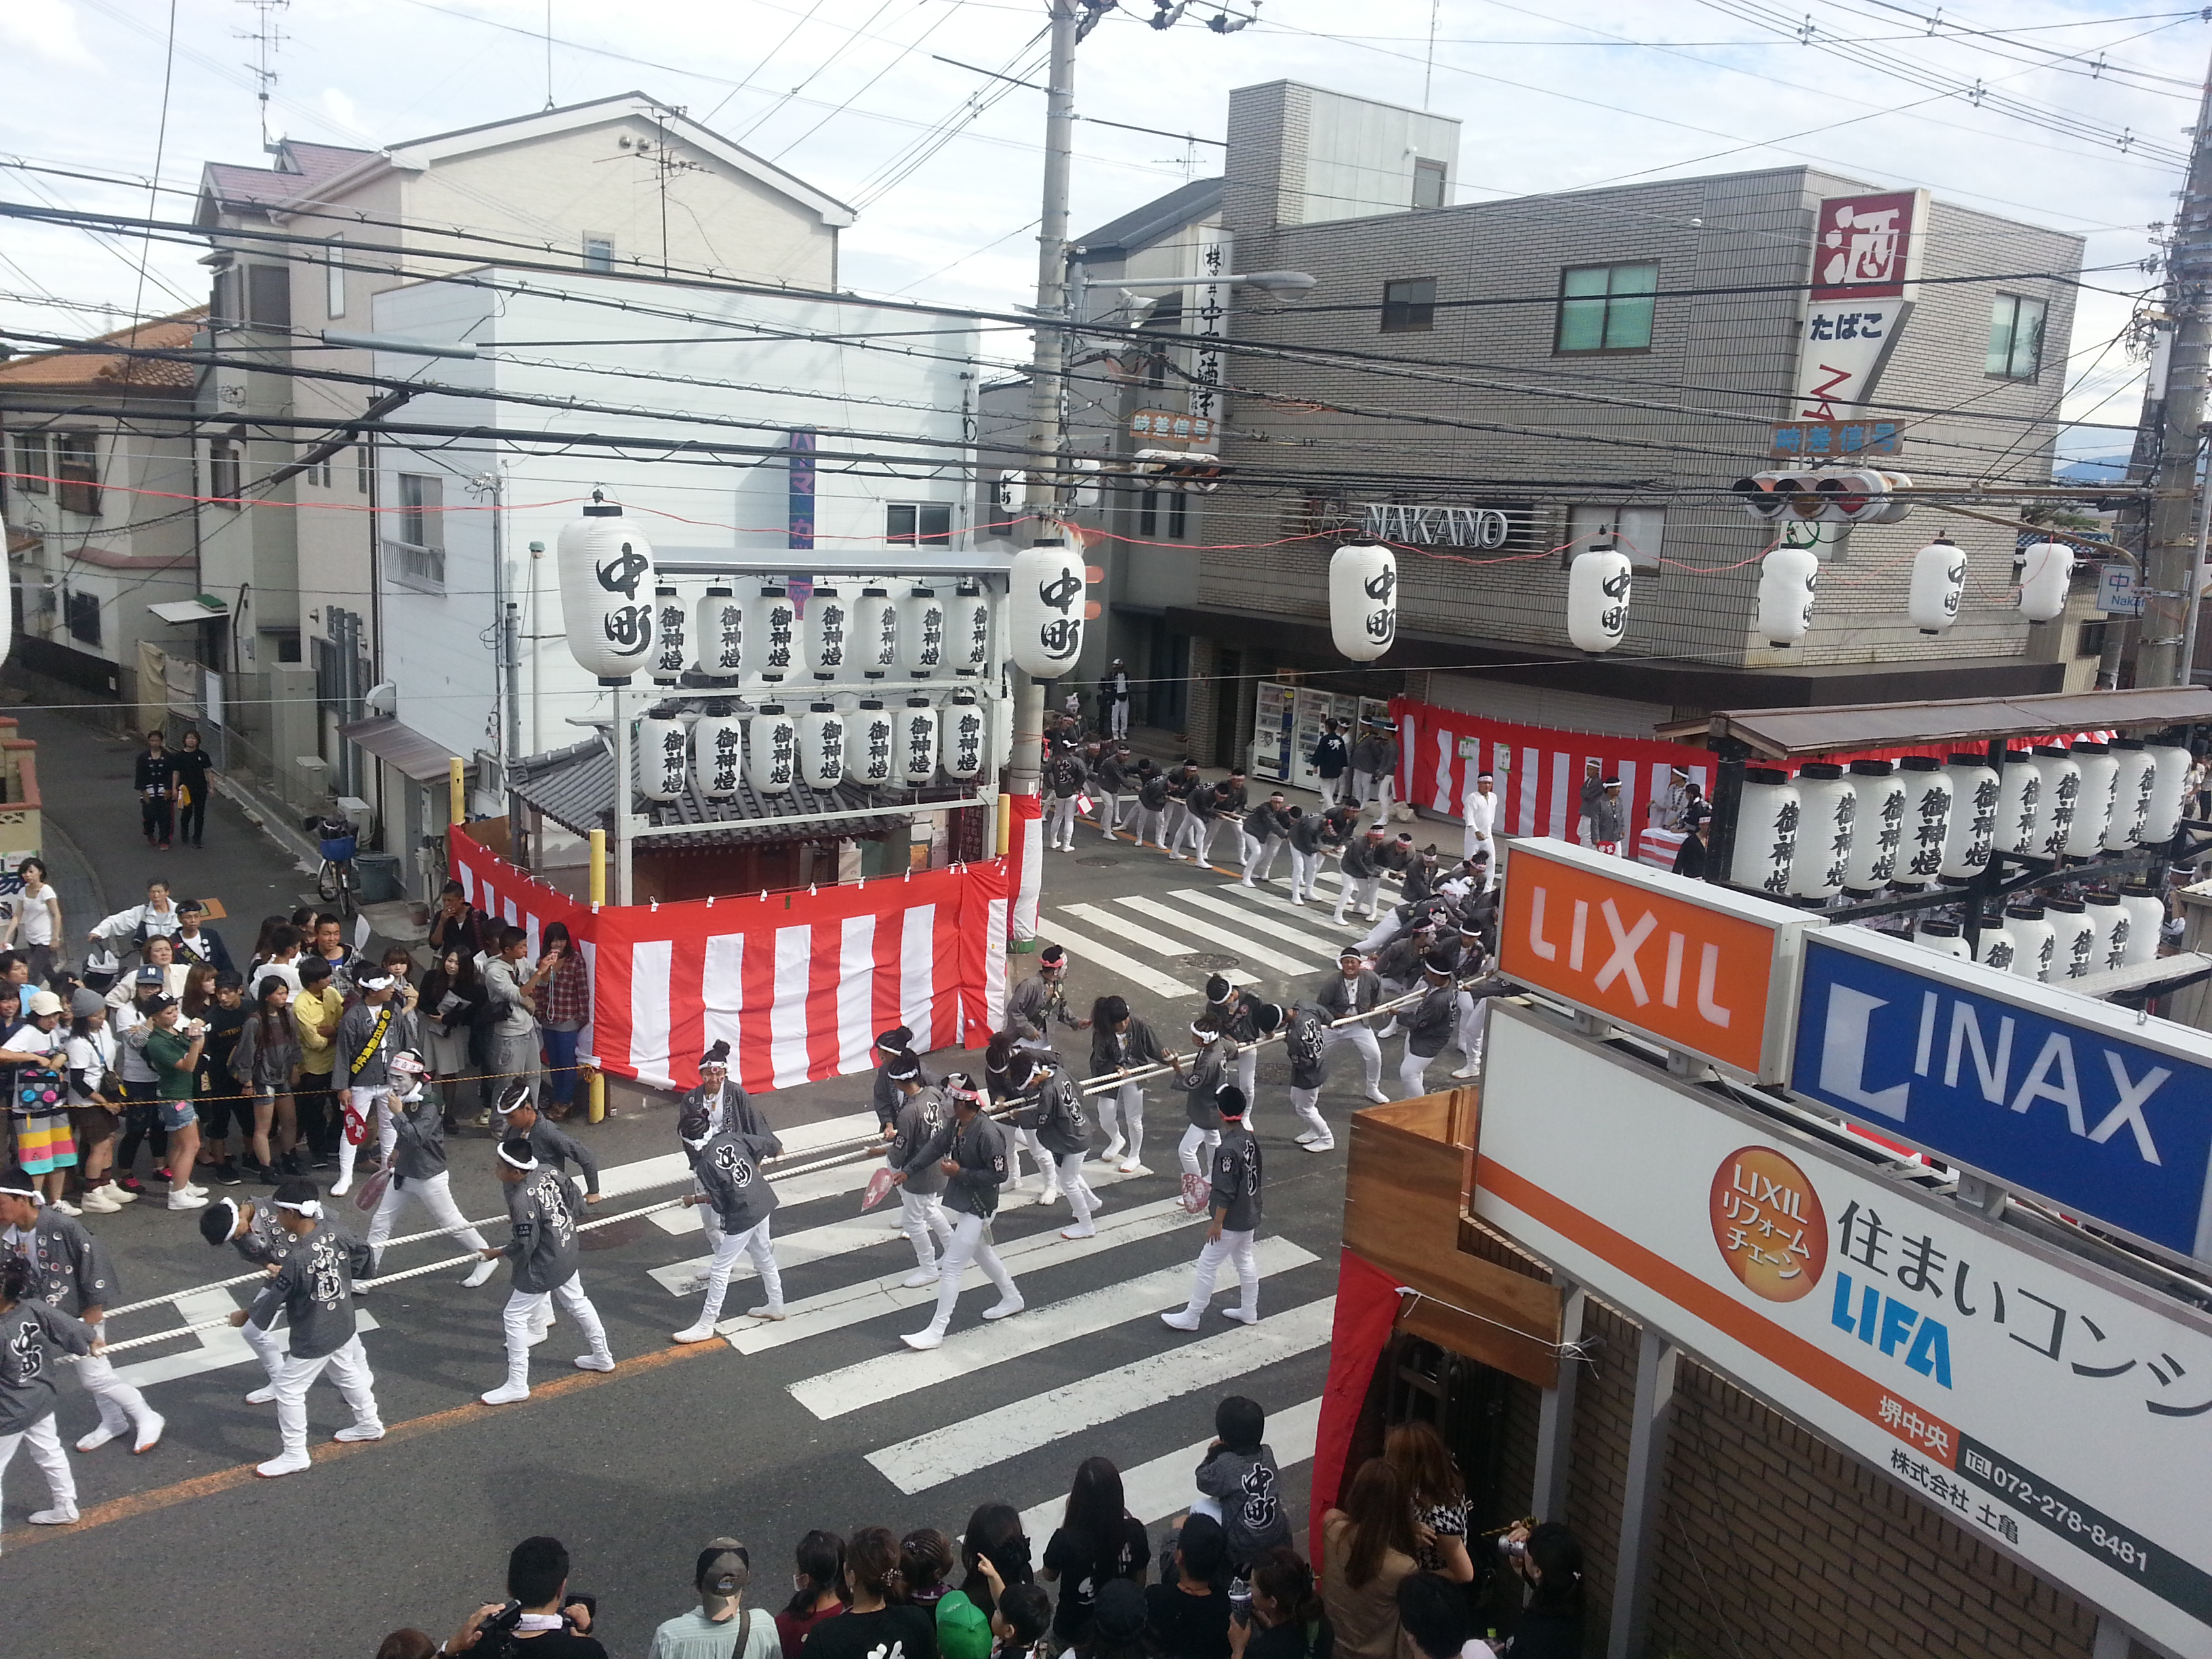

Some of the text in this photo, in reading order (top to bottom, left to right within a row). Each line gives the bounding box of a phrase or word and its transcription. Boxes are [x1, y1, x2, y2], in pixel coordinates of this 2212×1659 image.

[1823, 205, 1900, 289] 酒
[1809, 312, 1883, 341] たばこ
[1133, 414, 1210, 441] 時差信号
[1776, 423, 1898, 453] 時差信号
[1363, 505, 1509, 550] NAKANO
[596, 541, 653, 657] 中町
[1039, 567, 1082, 661] 中町
[1364, 564, 1397, 646] 中町
[1601, 566, 1631, 638] 中町
[1529, 885, 1732, 1029] LIXIL
[1913, 990, 2173, 1168] INAX
[1723, 1191, 1811, 1260] リフォーム
[1733, 1163, 1808, 1225] LIXIL
[1727, 1226, 1801, 1278] チェーン
[1830, 1271, 1952, 1391] LIFA
[1837, 1200, 2212, 1418] 住まいコンシ
[1878, 1395, 1950, 1458] 堺中央
[1890, 1447, 2019, 1545] 株式会社 土亀
[1968, 1452, 2148, 1572] TEL 072-278-8481
